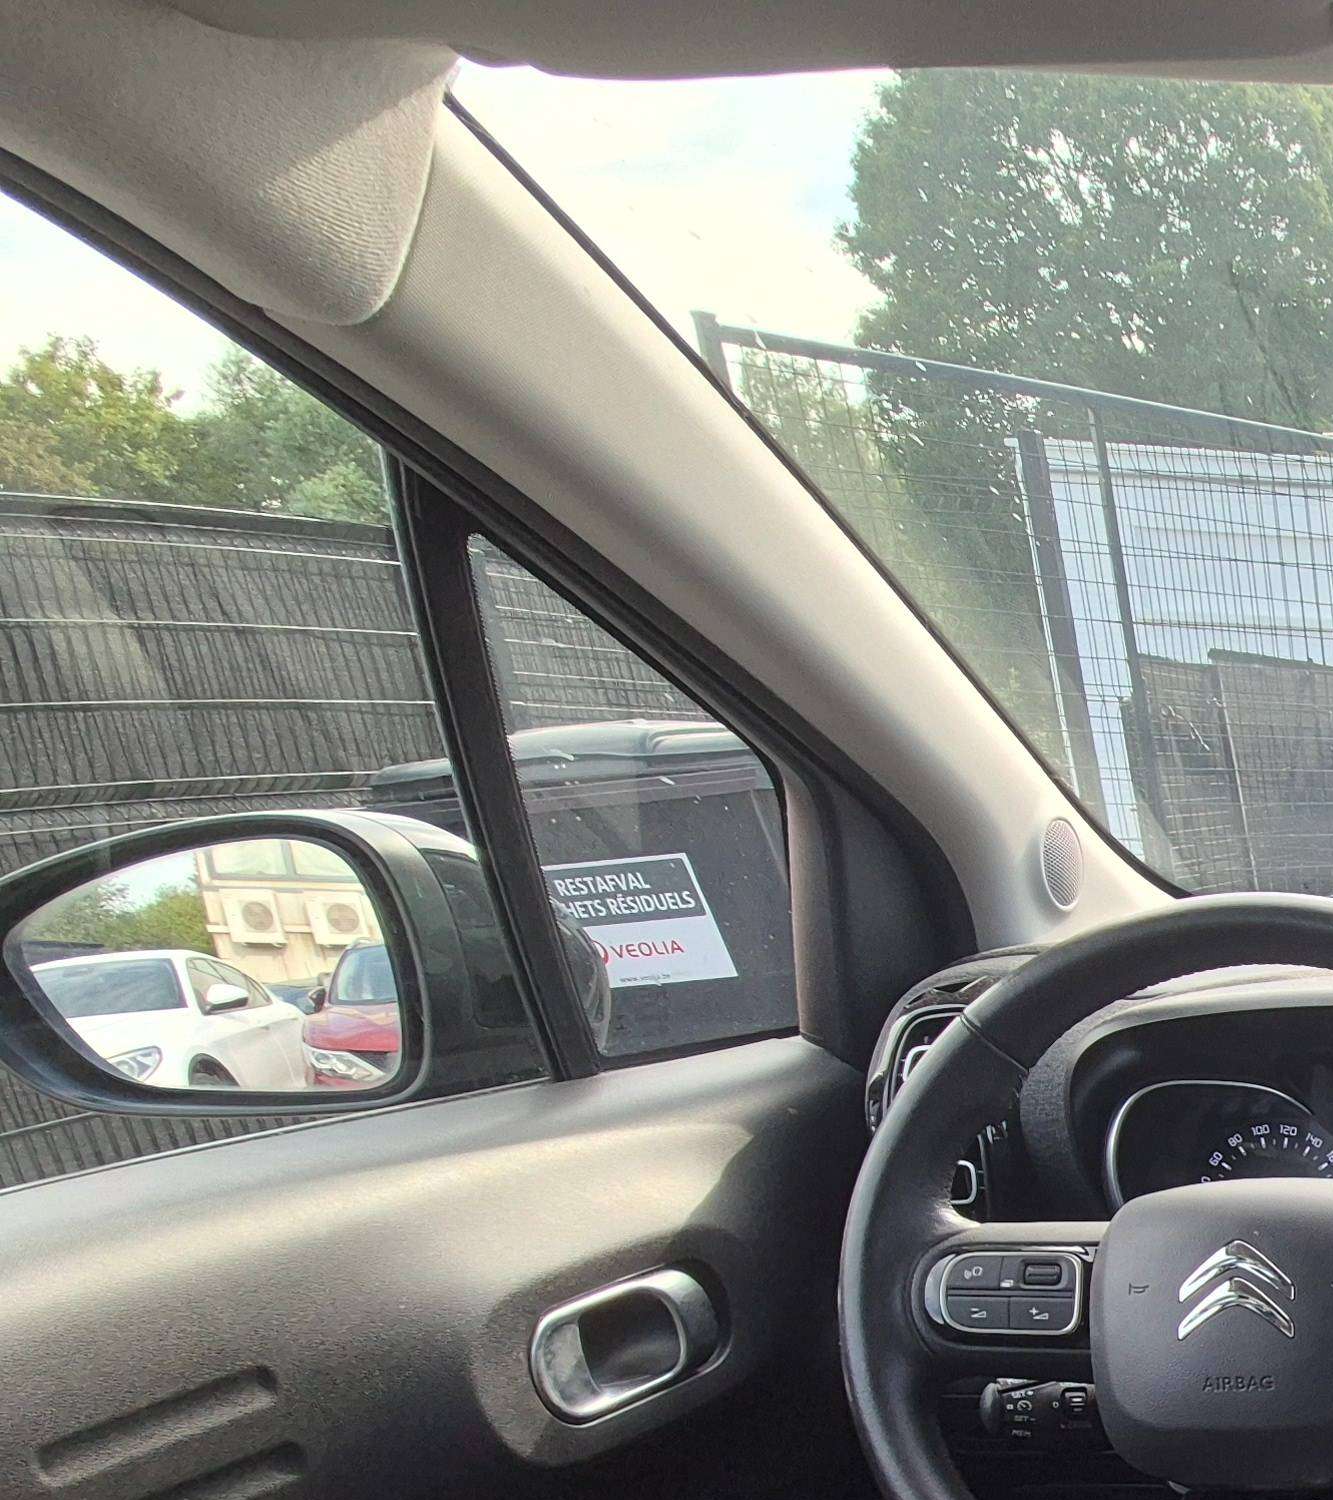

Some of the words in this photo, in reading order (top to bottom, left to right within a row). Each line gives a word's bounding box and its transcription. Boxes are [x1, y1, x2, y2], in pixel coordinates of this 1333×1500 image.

[553, 872, 651, 897] RESTAFVAL
[564, 900, 606, 919] HETS
[606, 891, 696, 916] RÉSIDUELS
[610, 940, 685, 959] VEOLIA
[1251, 1124, 1270, 1136] 100
[1279, 1124, 1298, 1136] 120
[1227, 1133, 1243, 1147] 80
[1305, 1132, 1323, 1149] 140
[1208, 1151, 1223, 1166] 60
[1202, 1375, 1275, 1392] AIRBAG
